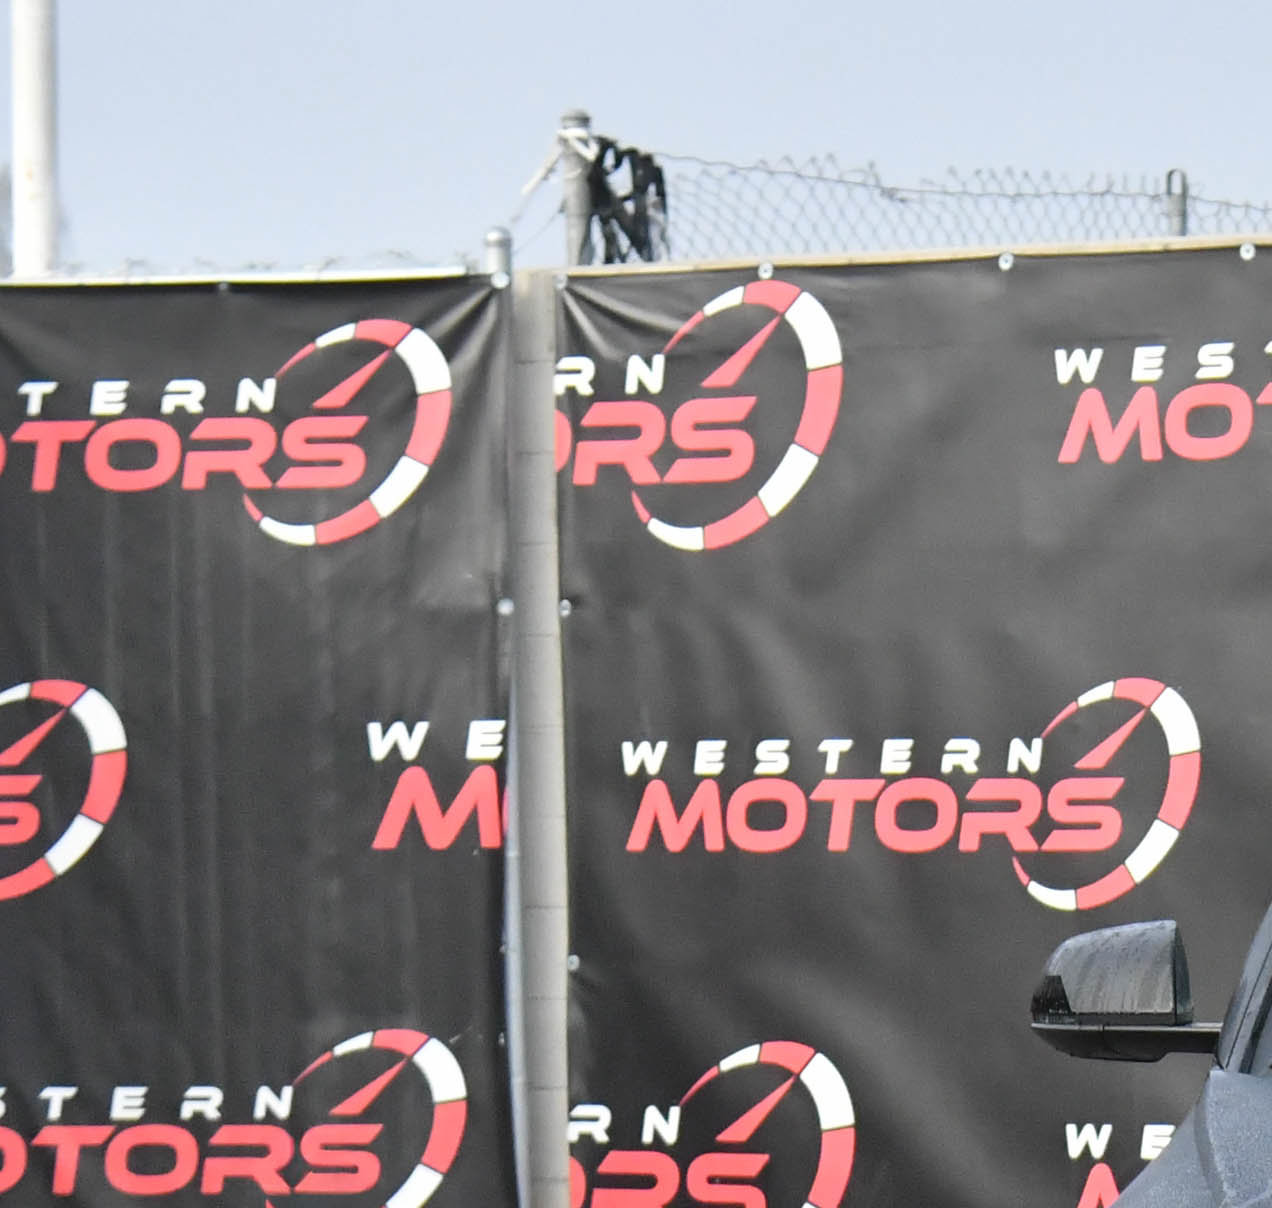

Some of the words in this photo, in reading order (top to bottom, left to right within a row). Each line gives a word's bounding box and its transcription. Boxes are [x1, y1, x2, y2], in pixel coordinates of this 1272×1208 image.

[0, 414, 369, 493] TORS
[554, 396, 758, 487] RS
[621, 737, 1042, 776] WESTERN
[625, 775, 1125, 854] MOTORS
[0, 1085, 293, 1121] TERN
